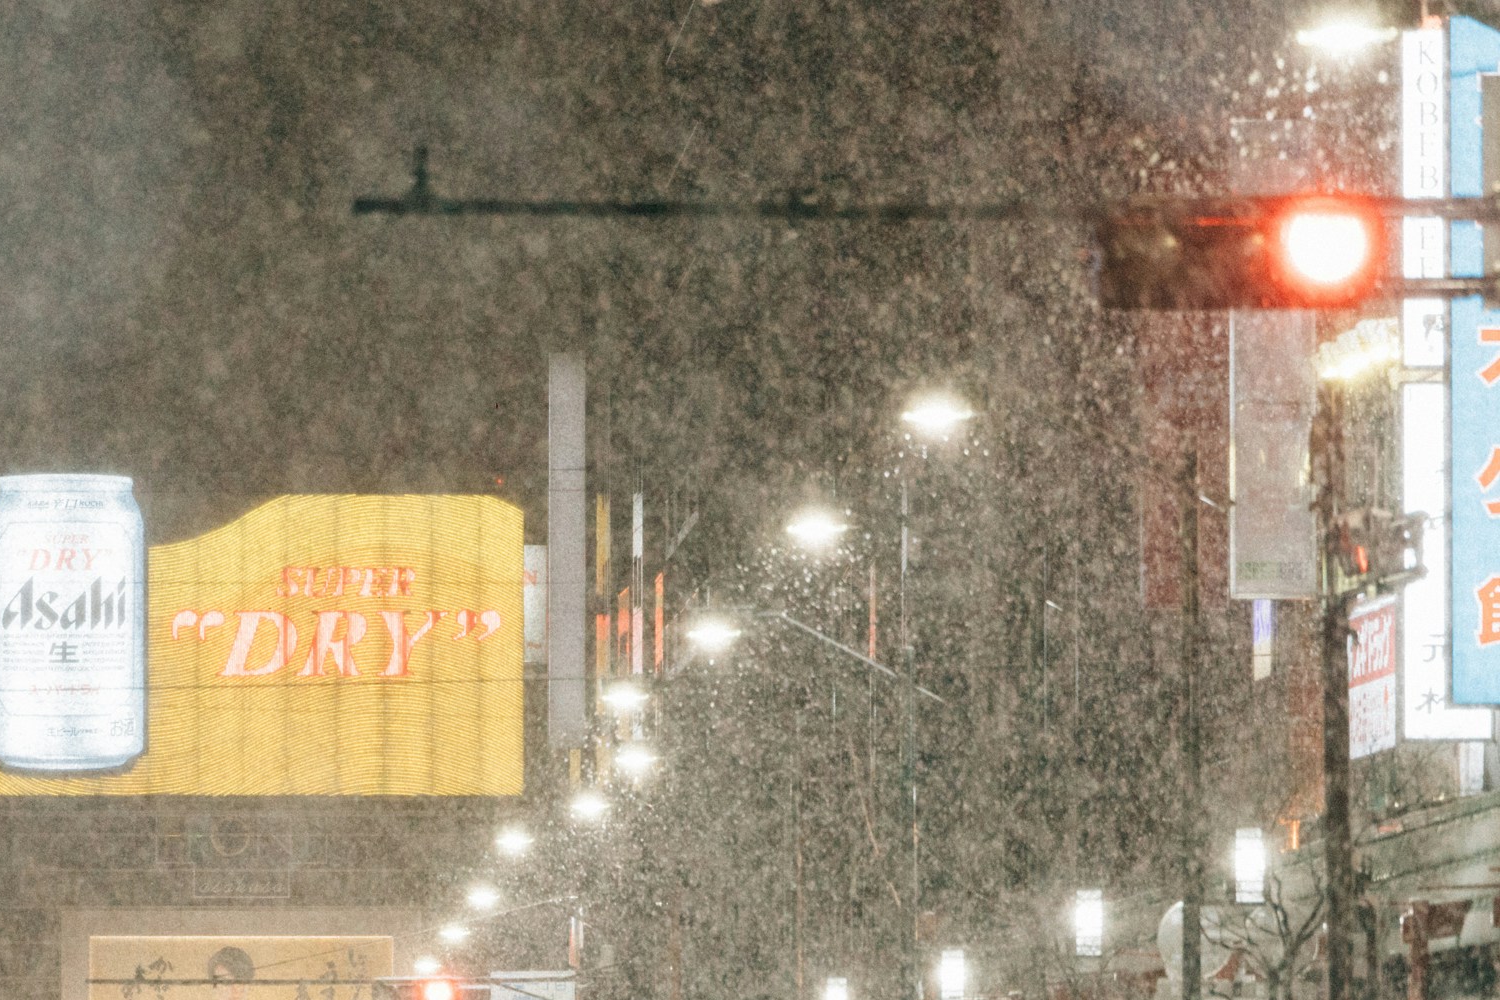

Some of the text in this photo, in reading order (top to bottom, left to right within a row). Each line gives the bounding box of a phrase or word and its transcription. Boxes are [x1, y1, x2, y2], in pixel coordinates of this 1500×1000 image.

[276, 565, 416, 598] SUPER
[1, 575, 126, 631] Asahi
[49, 641, 80, 664] 生
